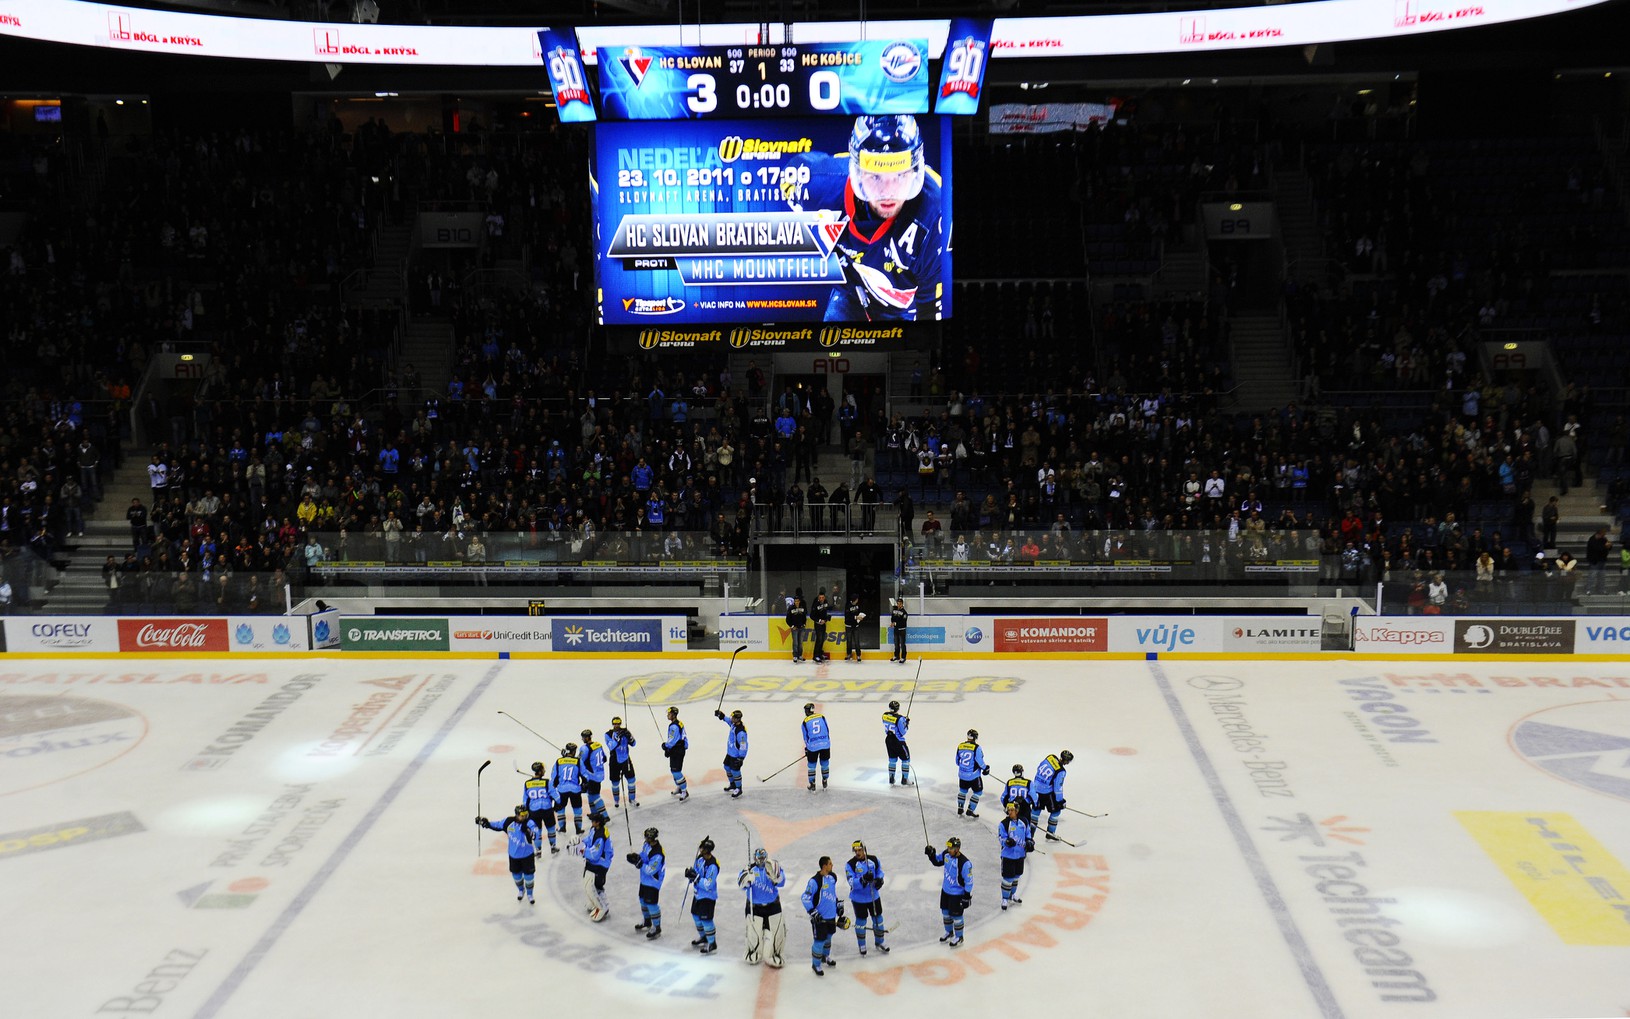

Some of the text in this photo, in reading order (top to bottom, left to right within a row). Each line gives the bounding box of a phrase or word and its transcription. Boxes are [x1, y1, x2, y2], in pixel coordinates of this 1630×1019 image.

[134, 32, 159, 43] BÖGL
[170, 35, 203, 47] KRÝSL
[342, 45, 371, 55] BÖGL
[383, 46, 419, 56] KRÝSL
[748, 48, 776, 58] PERIOD
[659, 56, 722, 69] HC SLOVAN
[801, 51, 862, 66] HC KOŠICE
[947, 47, 984, 82] 90
[550, 56, 584, 92] 90
[729, 59, 795, 80] 37 1 33
[687, 71, 841, 113] 3 0:00 0
[742, 138, 812, 153] Slovnaft
[618, 146, 723, 169] NEDEĽA
[618, 169, 647, 187] 23.
[653, 169, 681, 186] 10.
[687, 168, 734, 186] 2011
[756, 166, 810, 185] 17:00
[619, 190, 678, 204] SLOVNAFT
[738, 188, 810, 201] BRATISLAVA
[626, 221, 804, 247] HC SLOVAN BRATISLAVA
[1221, 220, 1251, 233] B9
[437, 229, 471, 241] B10
[635, 257, 829, 279] PROTI MHC MOUNTFIELD
[700, 300, 818, 309] VIAC INFO NA WWW.HCSLOVAN.SK
[660, 330, 721, 342] Slovnaft
[751, 328, 812, 341] Slovnaft
[840, 337, 876, 345] arena
[841, 327, 903, 340] Slovnaft
[750, 338, 785, 346] arena
[813, 359, 850, 373] A10
[1493, 354, 1526, 369] A9
[175, 364, 203, 377] A11
[32, 623, 92, 637] COFELY
[363, 629, 442, 640] TRANSPETROL
[493, 631, 531, 640] UniCredit
[585, 628, 650, 644] Techteam
[1021, 627, 1096, 637] KOMANDOR
[1246, 629, 1320, 637] LAMITE
[1371, 629, 1444, 644] Kappa
[735, 676, 1021, 694] Slovnaft
[198, 673, 326, 756] KOMANDOR
[1338, 676, 1440, 744] VACON
[812, 720, 821, 735] 5
[1203, 693, 1294, 798] Mercedes-Benz
[563, 766, 574, 781] 11
[854, 853, 1110, 996] EXTRALIGA
[1299, 851, 1438, 1003] Techteam
